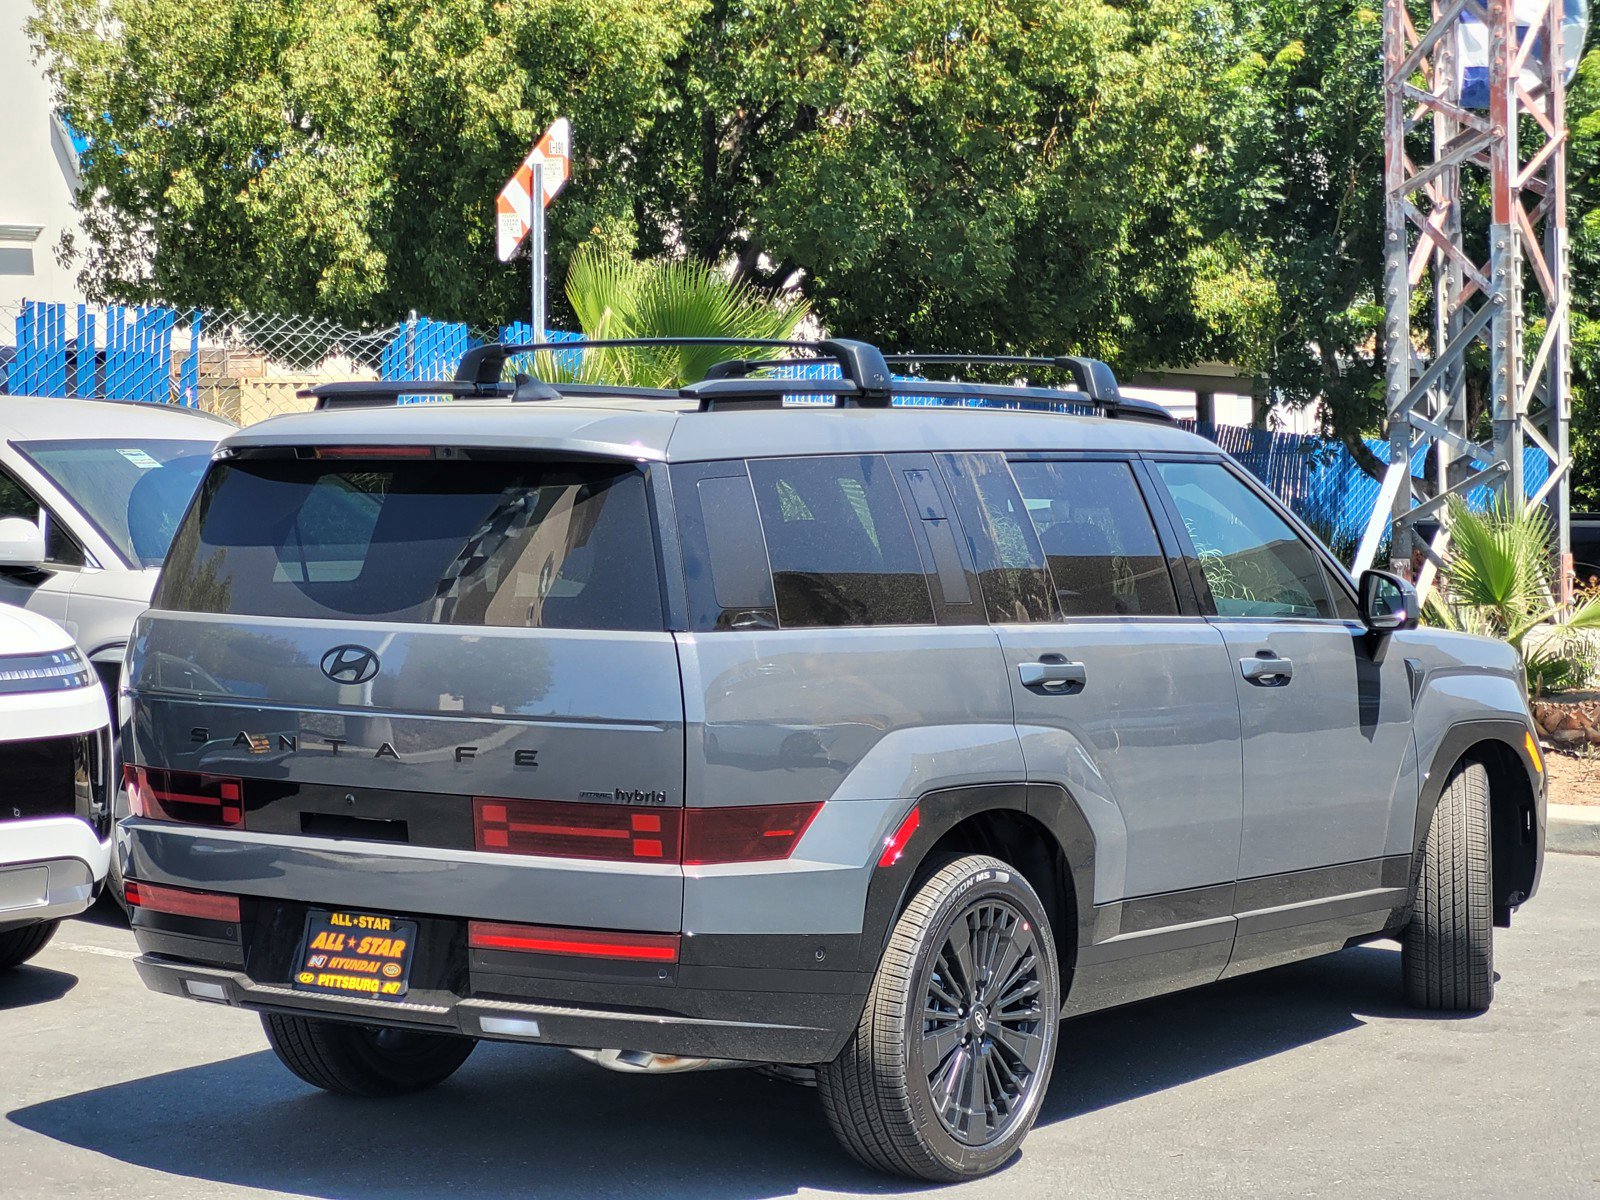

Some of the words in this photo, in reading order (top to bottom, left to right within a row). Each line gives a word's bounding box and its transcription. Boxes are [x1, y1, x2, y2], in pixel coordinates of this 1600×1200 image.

[190, 726, 401, 760] SANTA
[455, 745, 540, 767] FE
[615, 783, 667, 804] hybrid
[976, 871, 991, 883] MS
[330, 913, 352, 927] ALL
[359, 915, 391, 931] STAR
[310, 931, 346, 951] ALL
[356, 936, 406, 958] STAR
[328, 956, 381, 973] HYUNDAI
[317, 973, 380, 992] PITTSBURG
